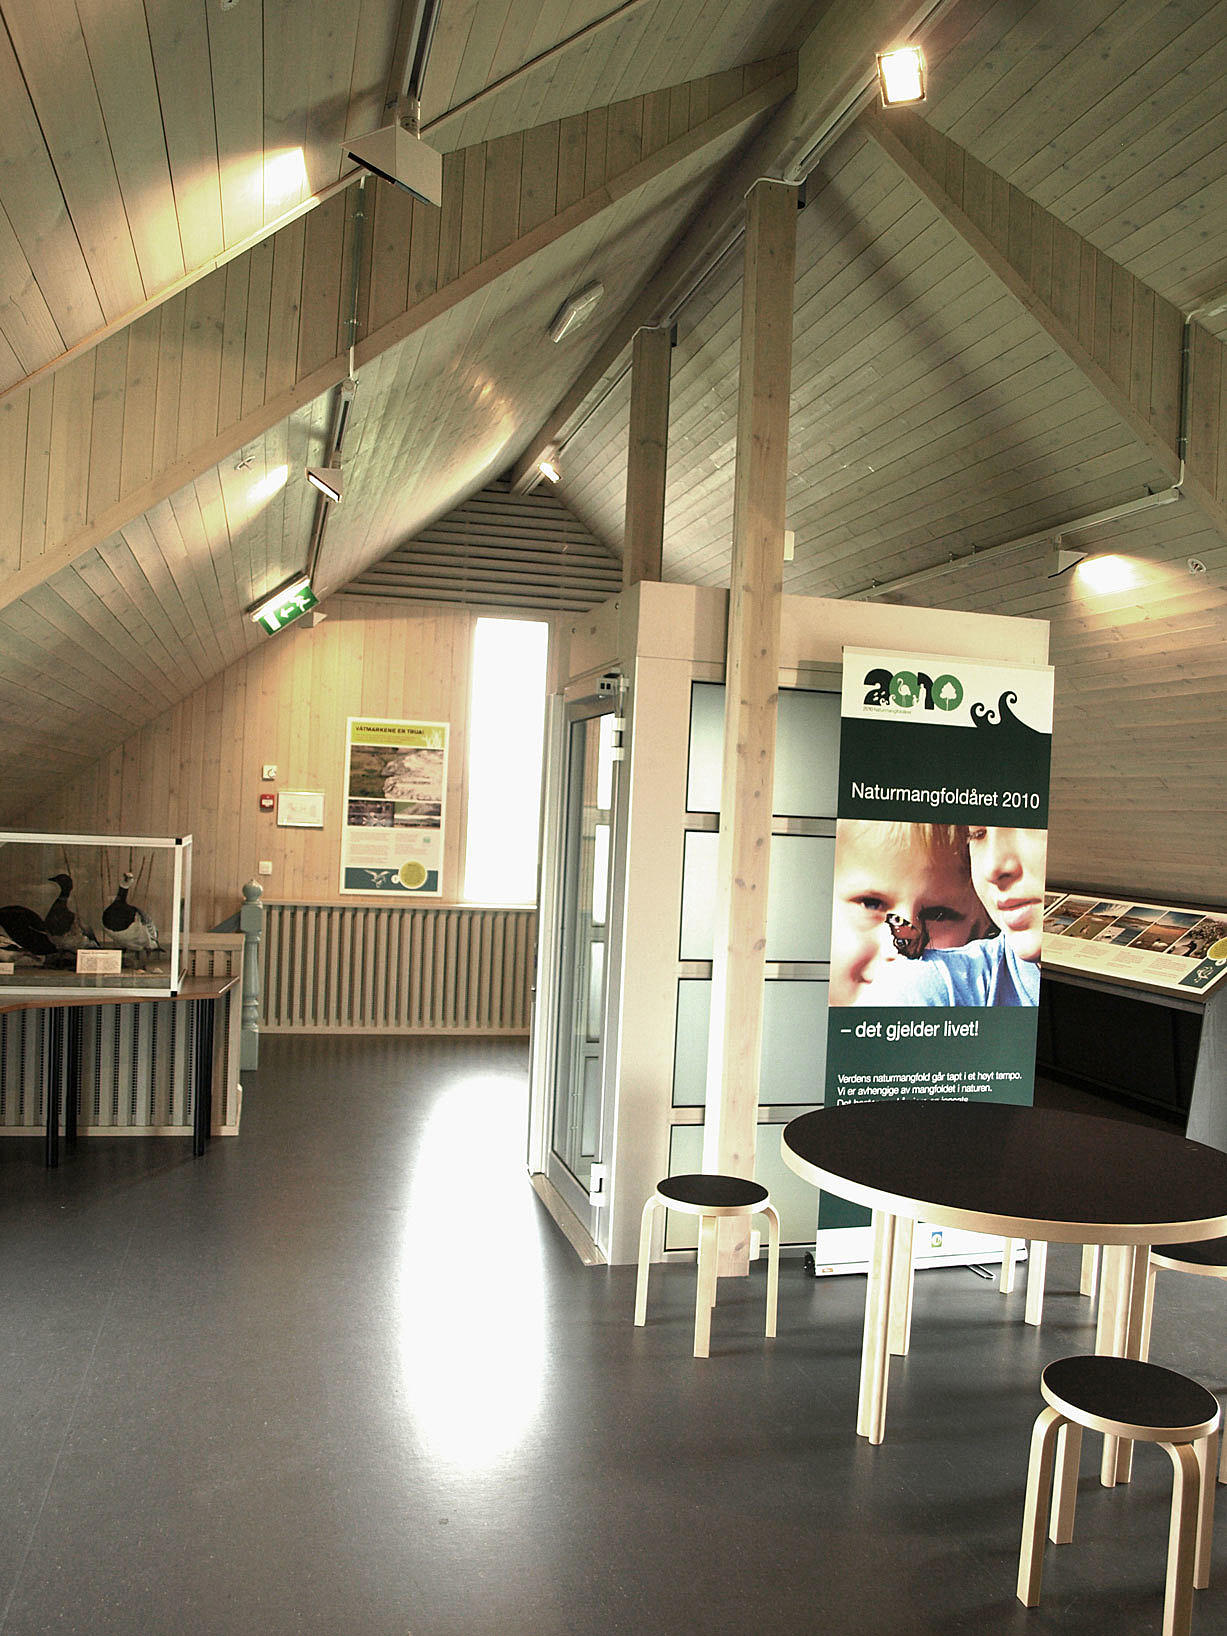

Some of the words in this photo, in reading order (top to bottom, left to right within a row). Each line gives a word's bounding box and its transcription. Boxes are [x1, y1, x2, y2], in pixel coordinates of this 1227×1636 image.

[864, 669, 963, 711] 2010
[851, 782, 998, 808] Naturmangfoldåret
[1002, 791, 1040, 809] 2010
[855, 1021, 882, 1038] det
[886, 1021, 940, 1041] gjelder
[944, 1020, 979, 1037] livet!
[837, 1073, 871, 1083] Verdens
[873, 1072, 930, 1084] naturmangfold
[931, 1071, 945, 1083] går
[946, 1072, 962, 1082] tapt
[963, 1072, 967, 1080] i
[967, 1072, 976, 1080] et
[977, 1071, 994, 1081] høyt
[995, 1071, 1022, 1081] tempo.
[837, 1086, 846, 1096] Vi
[847, 1088, 856, 1096] er
[857, 1086, 899, 1097] avhengige
[911, 1084, 956, 1095] mangfoldet
[961, 1084, 993, 1093] naturen.
